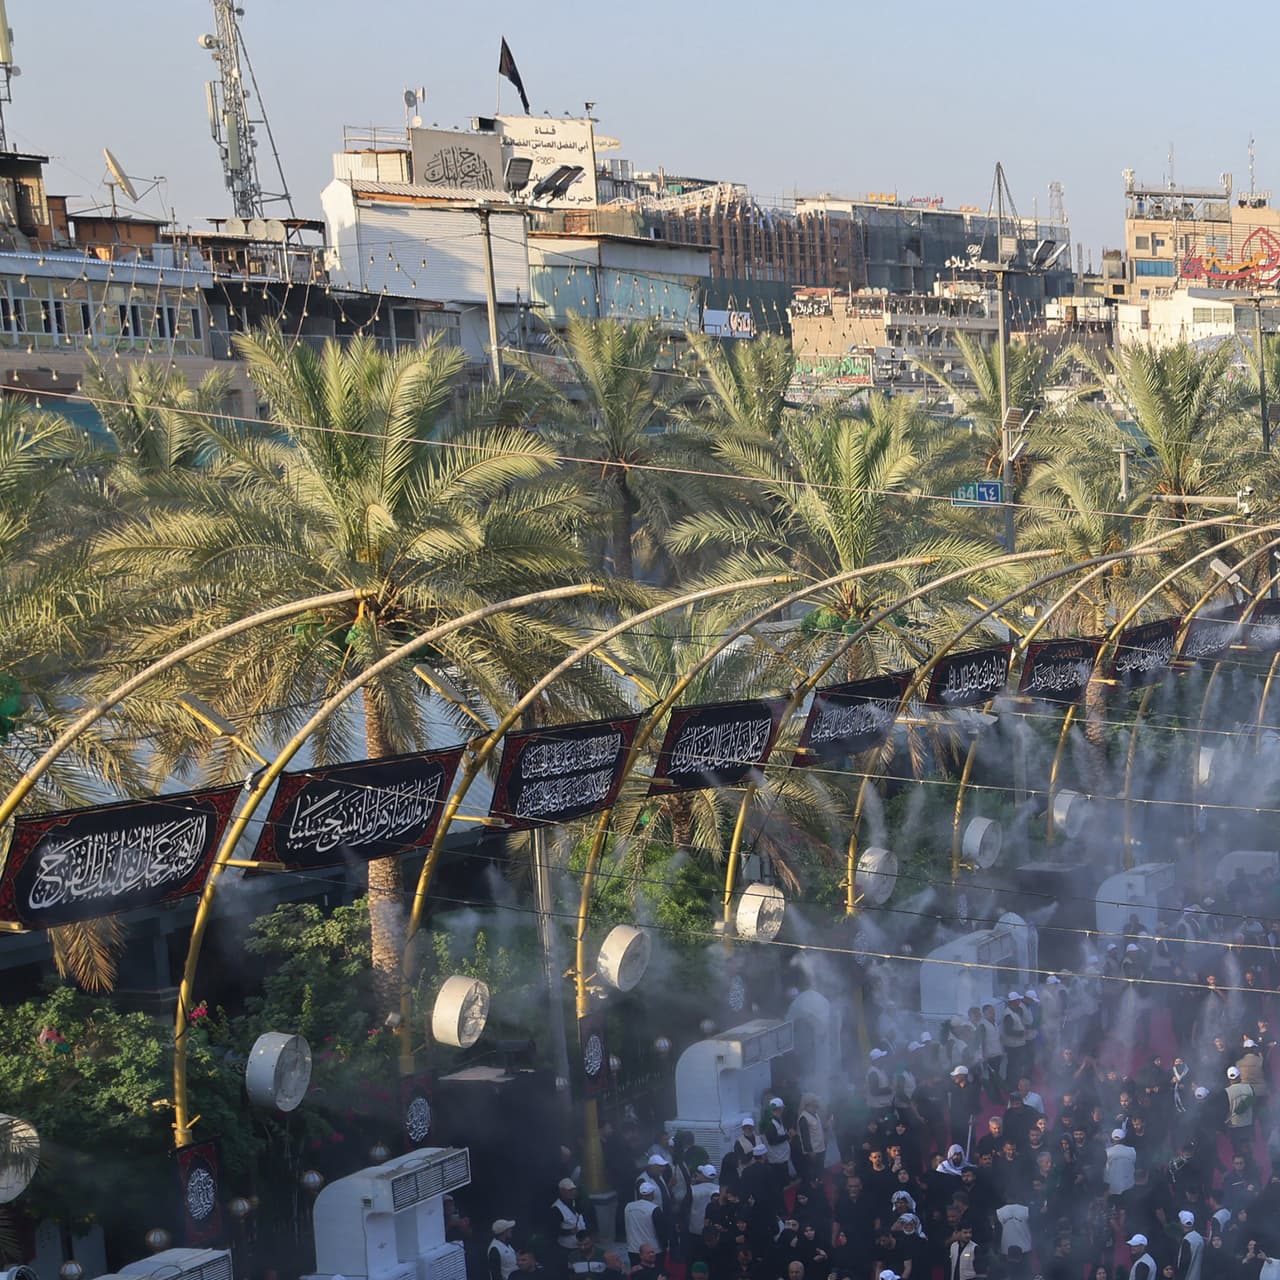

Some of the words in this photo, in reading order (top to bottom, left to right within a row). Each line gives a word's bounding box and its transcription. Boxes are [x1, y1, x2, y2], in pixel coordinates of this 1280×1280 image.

[535, 125, 556, 136] قناة
[531, 140, 556, 152] العباس
[556, 141, 577, 152] الفضل
[577, 142, 589, 152] أبي
[944, 256, 978, 271] كربلاء
[957, 486, 975, 501] 64
[980, 487, 997, 501] ٦٤
